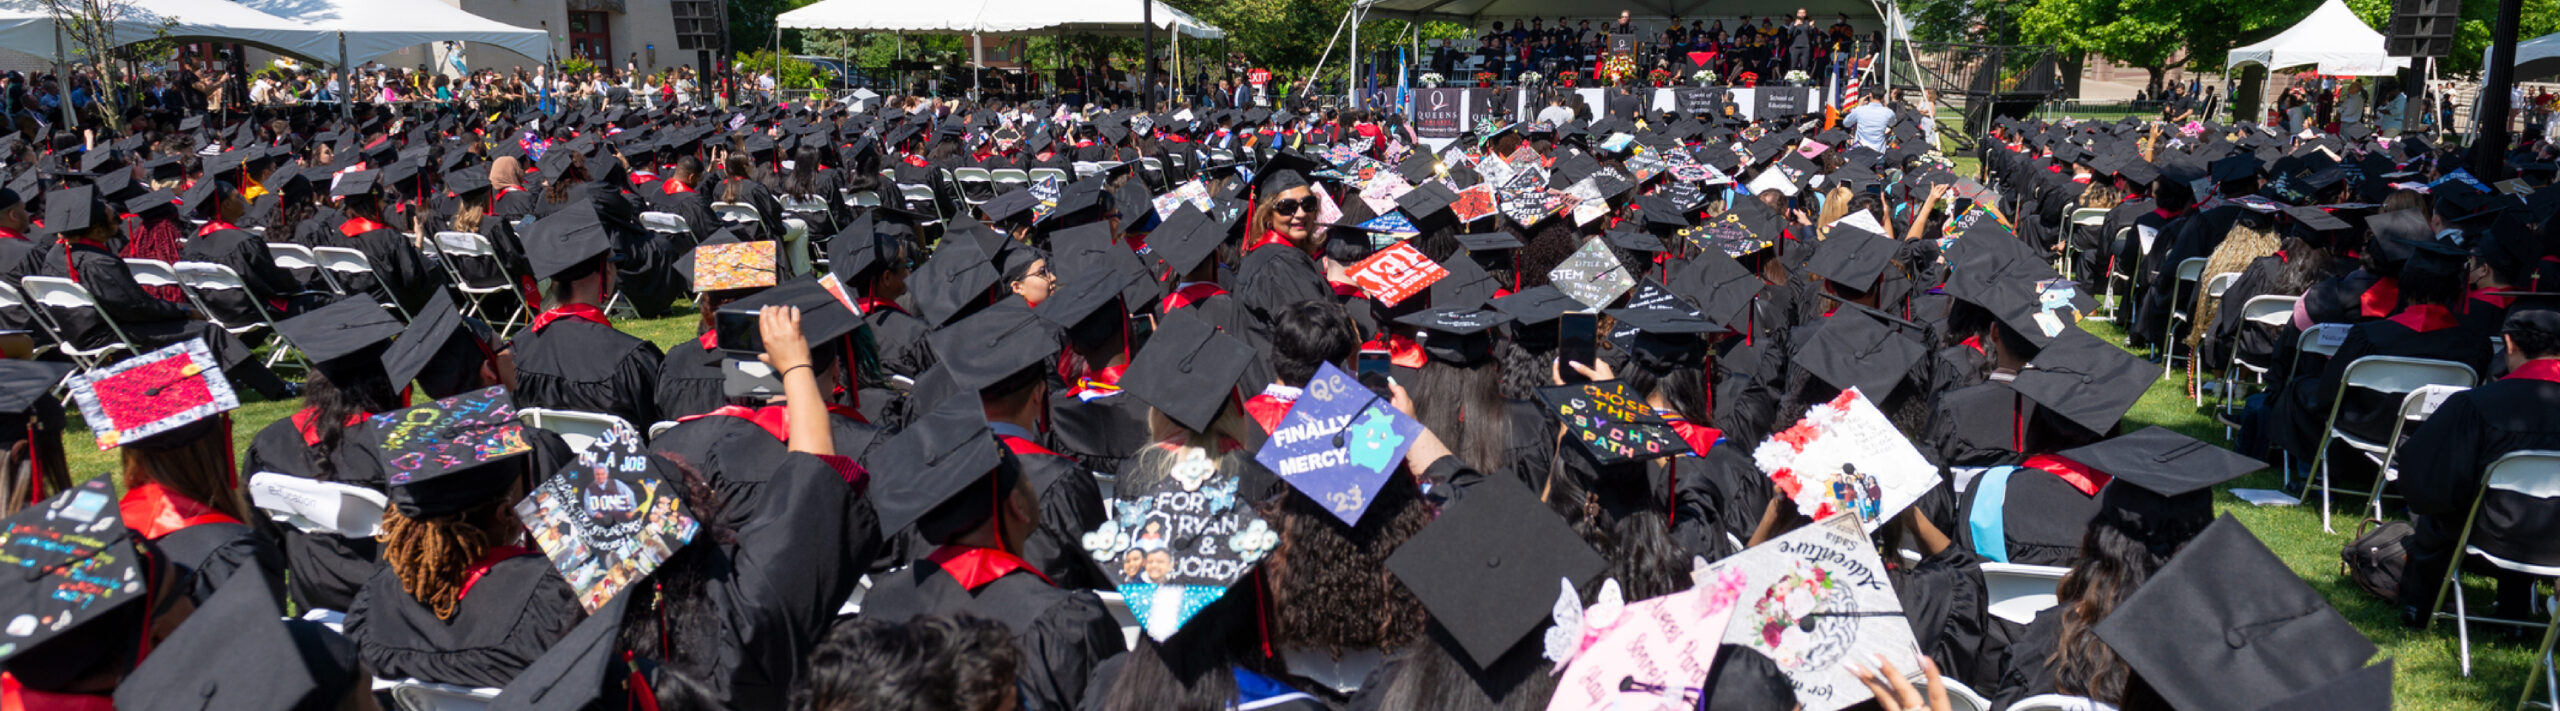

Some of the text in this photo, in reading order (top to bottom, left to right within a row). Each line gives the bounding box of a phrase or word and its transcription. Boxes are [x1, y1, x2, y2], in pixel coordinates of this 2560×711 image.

[1247, 72, 1268, 82] EXIT
[1417, 111, 1457, 120] QUEENS
[1550, 269, 1585, 280] STEM
[1310, 375, 1346, 402] QC
[1617, 384, 1623, 394] I
[1584, 385, 1651, 416] CHOSE
[1593, 399, 1636, 423] THE
[594, 422, 639, 453] KUDOS
[1561, 404, 1660, 453] PSYCHO
[1583, 430, 1634, 458] PATH
[578, 452, 647, 472] ON A JOB
[1279, 447, 1349, 476] MERCY.
[1157, 492, 1204, 511] FOR
[1178, 514, 1240, 535] RYAN
[1199, 536, 1217, 555] &
[1825, 531, 1859, 551] Sadia
[1170, 556, 1247, 580] JORDY
[1778, 540, 1887, 590] Adventure
[1677, 639, 1709, 683] Para
[1807, 684, 1833, 701] for
